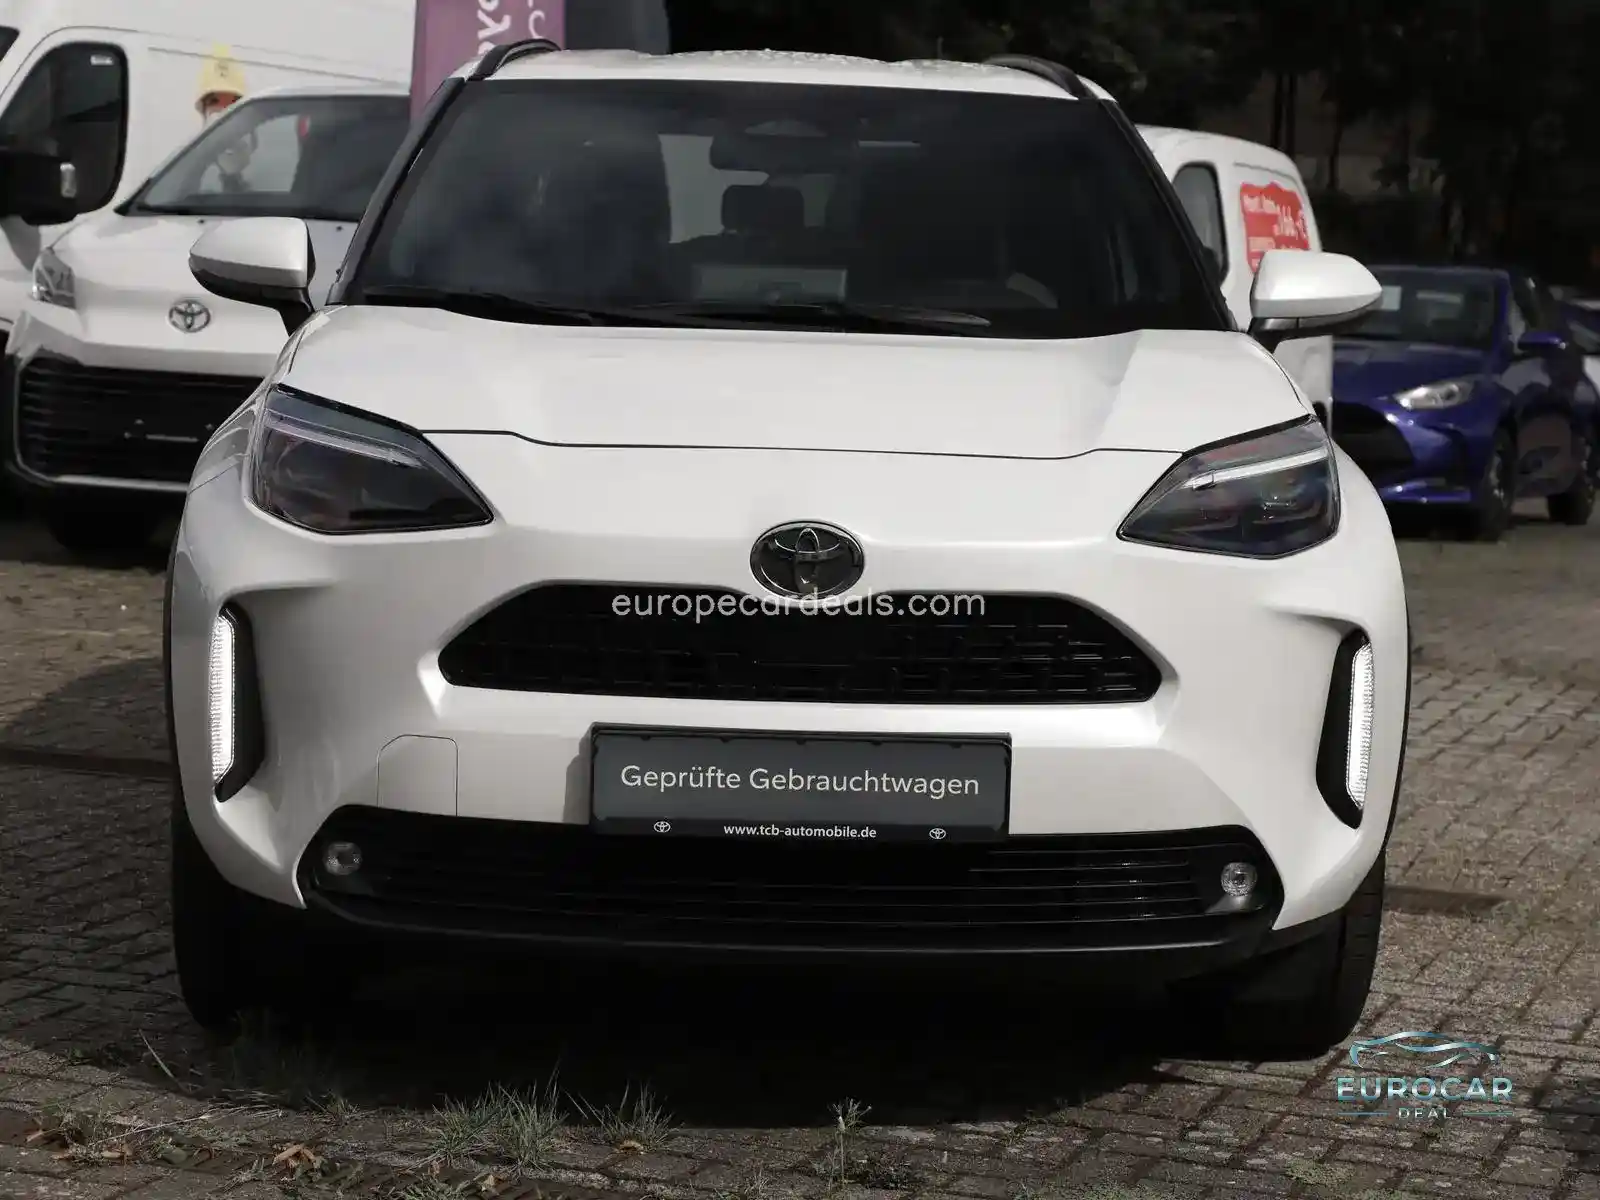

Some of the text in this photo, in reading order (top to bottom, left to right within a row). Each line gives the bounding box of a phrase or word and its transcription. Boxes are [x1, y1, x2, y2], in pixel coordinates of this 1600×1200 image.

[621, 765, 979, 799] Geprüfte Gebrauchtwagen
[723, 824, 877, 838] www.tcb-automobile.de
